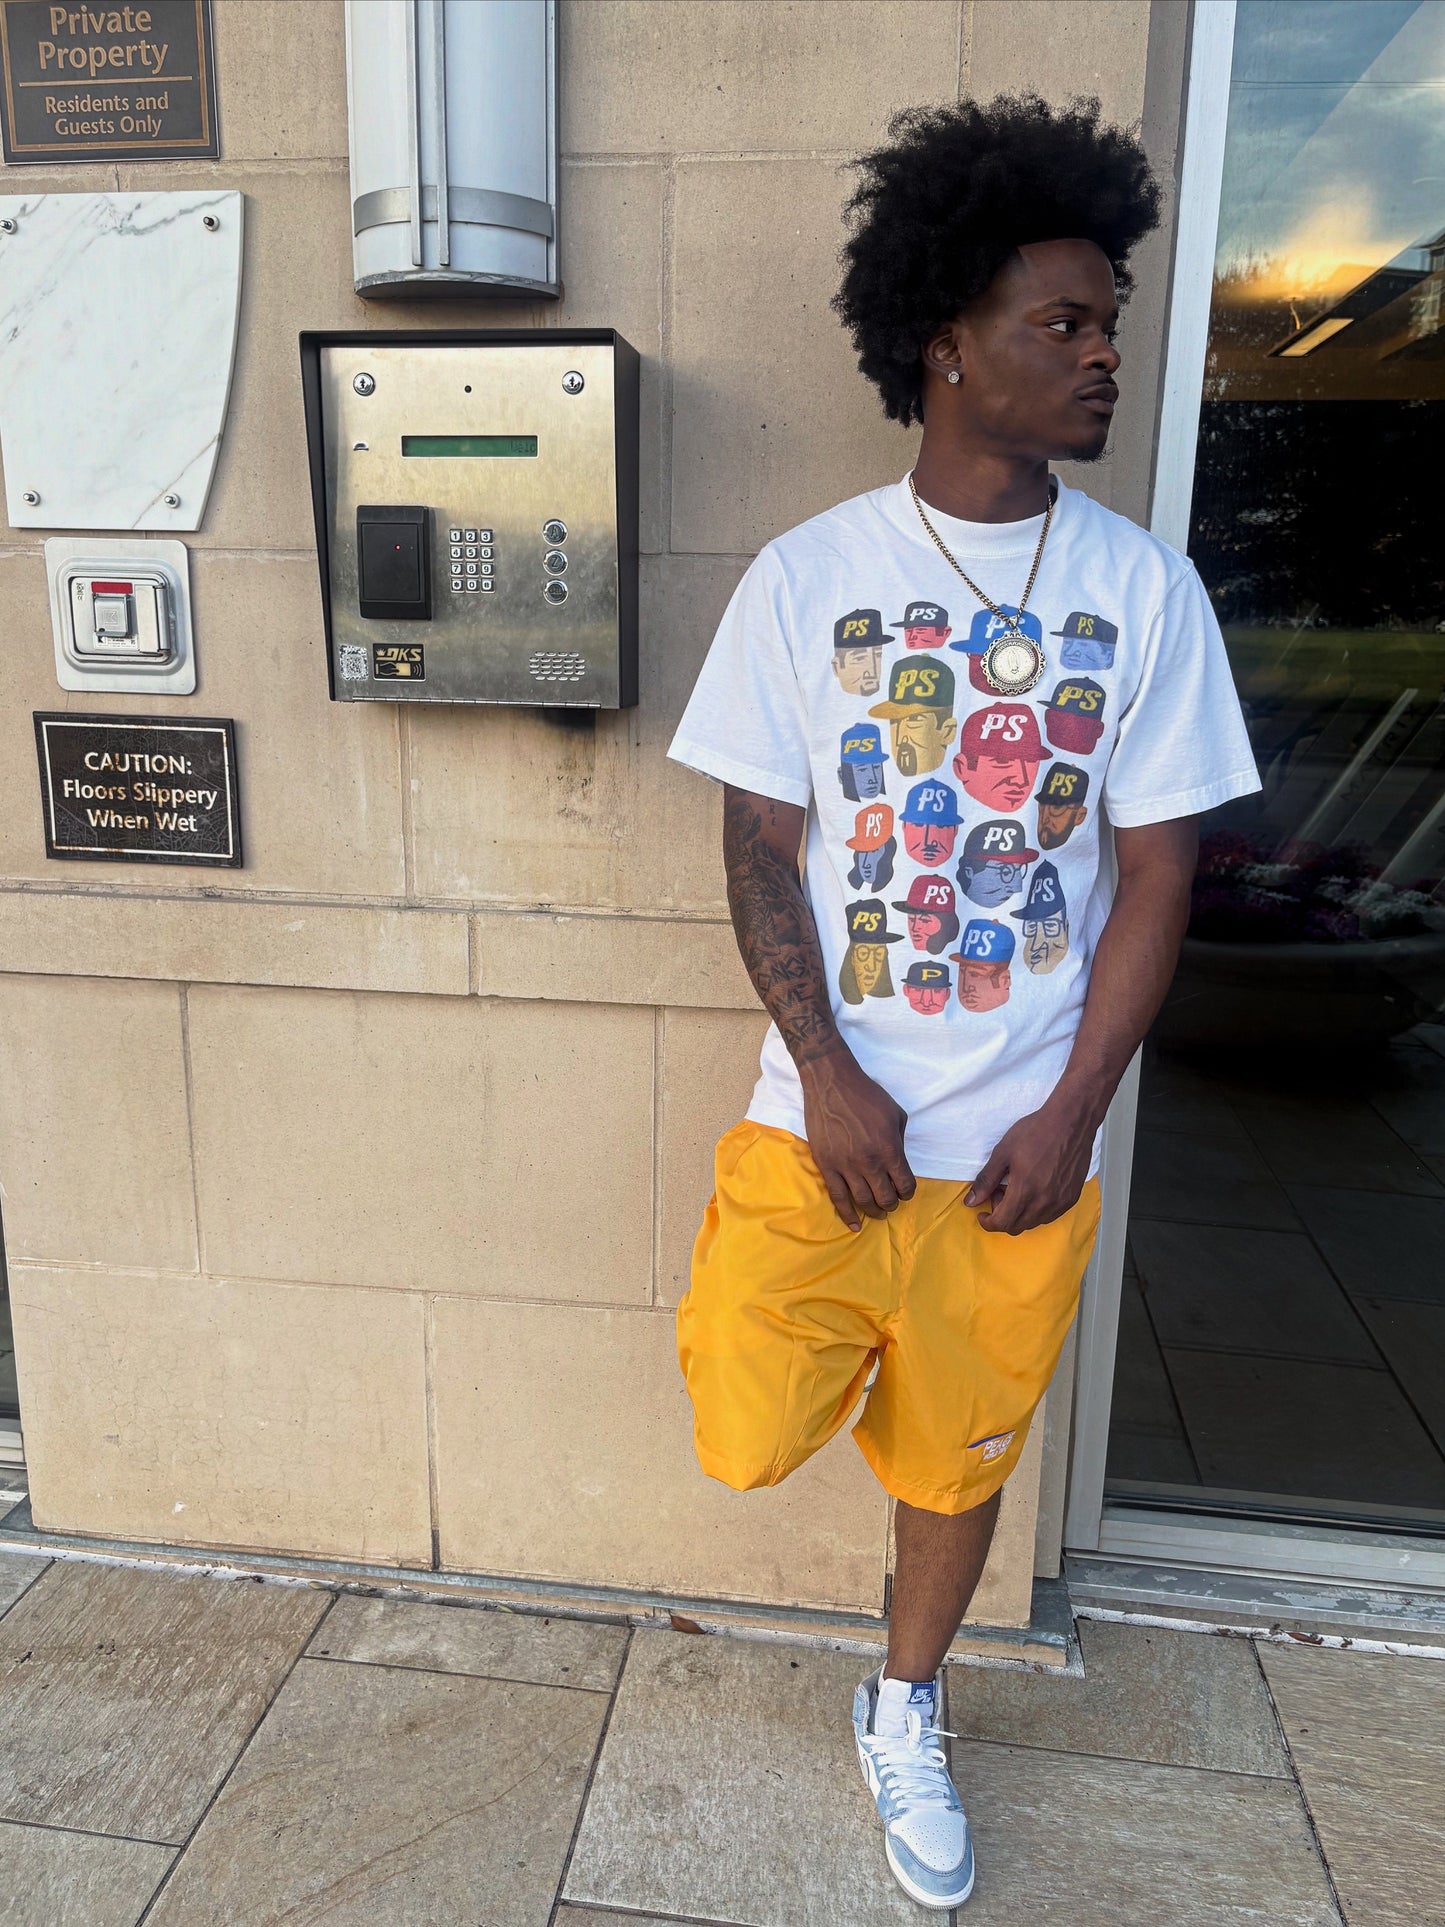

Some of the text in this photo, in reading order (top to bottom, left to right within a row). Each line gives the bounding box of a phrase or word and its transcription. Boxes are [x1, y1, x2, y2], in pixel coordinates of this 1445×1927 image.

[50, 5, 152, 36] Private
[38, 39, 168, 77] Property
[45, 91, 169, 114] Residents and
[54, 114, 162, 138] Guests Only
[909, 608, 939, 621] PS
[1077, 616, 1094, 636] PS
[842, 619, 870, 639] PS
[376, 647, 422, 662] DKS
[894, 669, 940, 700] PS
[1056, 685, 1102, 711] PS
[979, 713, 1028, 742] PS
[843, 737, 877, 754] PS
[84, 752, 193, 775] CAUTION:
[62, 779, 218, 810] Floors Slippery
[1048, 772, 1078, 797] PS
[917, 787, 948, 812] PS
[86, 808, 198, 833] When Wet
[865, 812, 883, 838] PS
[982, 827, 1018, 852] PS
[923, 885, 951, 905] PS
[1031, 877, 1055, 904] PS
[852, 911, 882, 932] PS
[963, 928, 996, 957] PS
[921, 968, 943, 982] P
